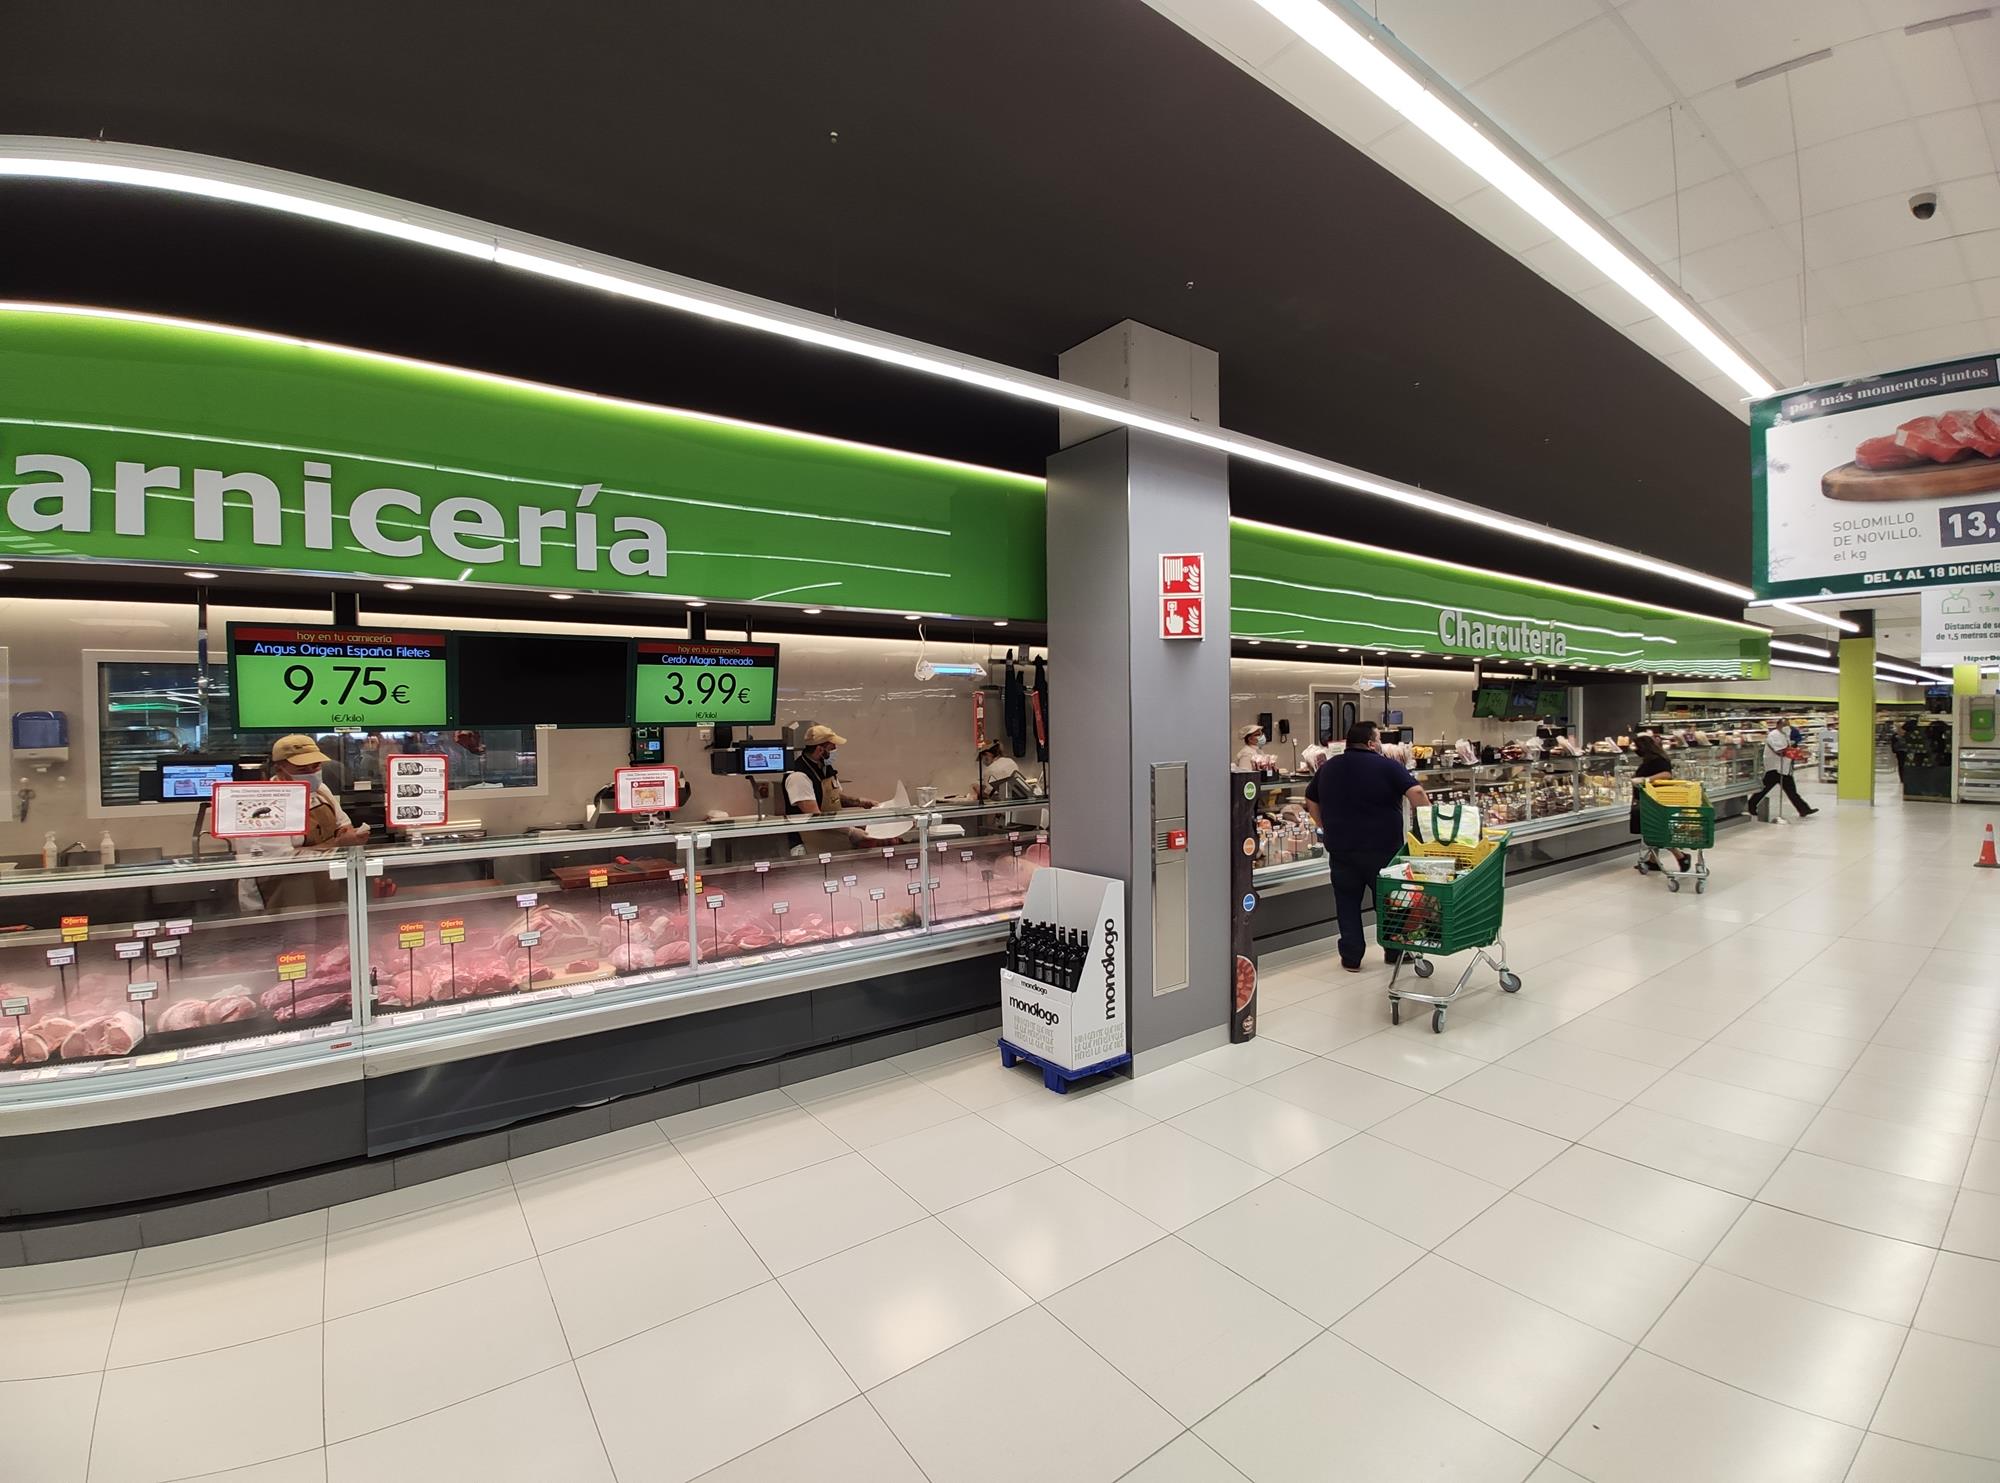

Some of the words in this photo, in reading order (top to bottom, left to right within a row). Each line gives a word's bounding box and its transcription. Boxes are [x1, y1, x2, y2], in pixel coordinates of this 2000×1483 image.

[1790, 401, 1816, 416] por
[1821, 392, 1853, 407] más
[1857, 375, 1937, 399] momentos
[1940, 367, 1989, 387] juntos
[7, 454, 667, 577] arnicería
[1833, 512, 1914, 532] SOLOMILLO
[1948, 511, 2000, 539] 13,
[1834, 536, 1851, 547] DE
[1834, 551, 1846, 561] el
[1851, 550, 1867, 561] kg
[1864, 574, 1890, 584] DEL
[1894, 572, 1902, 581] 4
[1906, 569, 1925, 580] AL
[1929, 567, 1945, 578] 18
[1944, 622, 1980, 630] Distancia
[297, 632, 314, 643] hoy
[334, 633, 344, 642] tu
[1439, 609, 1567, 656] Charcutería
[254, 643, 296, 656] Angus
[300, 644, 343, 658] Origen
[347, 645, 392, 659] España
[396, 646, 430, 658] Filetes
[662, 655, 687, 665] Cerdo
[689, 656, 716, 666] Magro
[719, 656, 753, 666] Troceado
[331, 714, 364, 723] (€/kilo)
[63, 918, 88, 926] Oferta
[440, 920, 464, 928] Oferta
[280, 954, 306, 963] Oferta
